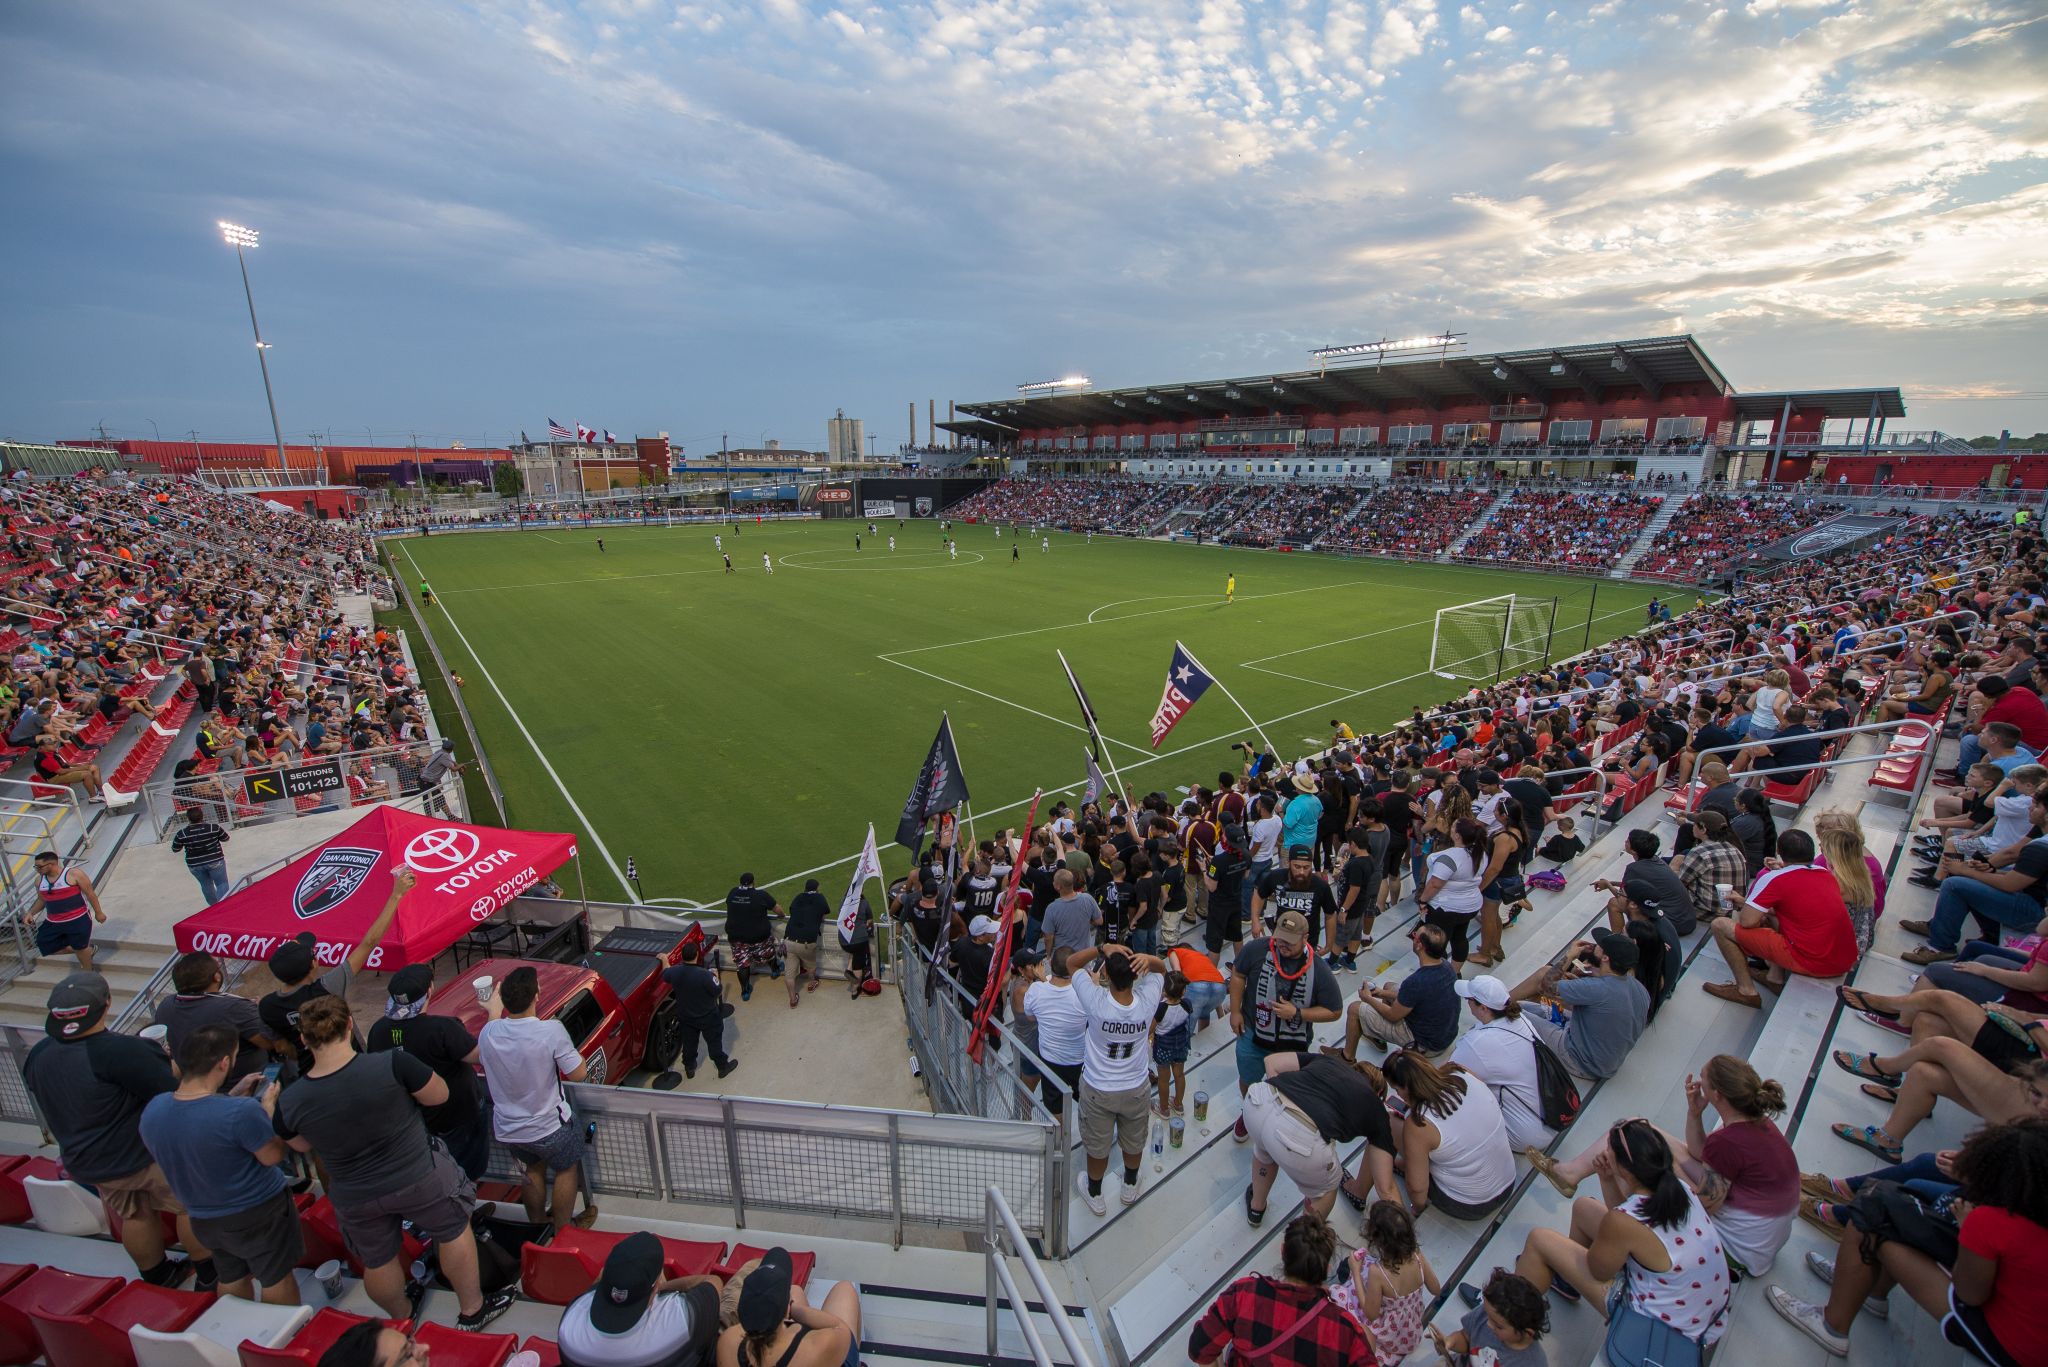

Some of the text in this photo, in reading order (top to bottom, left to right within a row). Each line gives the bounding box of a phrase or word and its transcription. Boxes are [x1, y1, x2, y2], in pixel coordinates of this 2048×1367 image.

[289, 767, 334, 780] SECTIONS
[290, 776, 339, 793] 101-129
[323, 854, 371, 865] SAN ANTONIO
[434, 848, 518, 895] TOYOTA
[493, 866, 537, 899] TOYOTA
[500, 876, 540, 907] Let's Go Places
[974, 891, 993, 906] 118
[1275, 896, 1313, 909] SPURS
[192, 930, 232, 954] OUR
[234, 934, 276, 959] CITY
[1101, 1020, 1147, 1034] CORDOVA
[1107, 1041, 1135, 1060] 11
